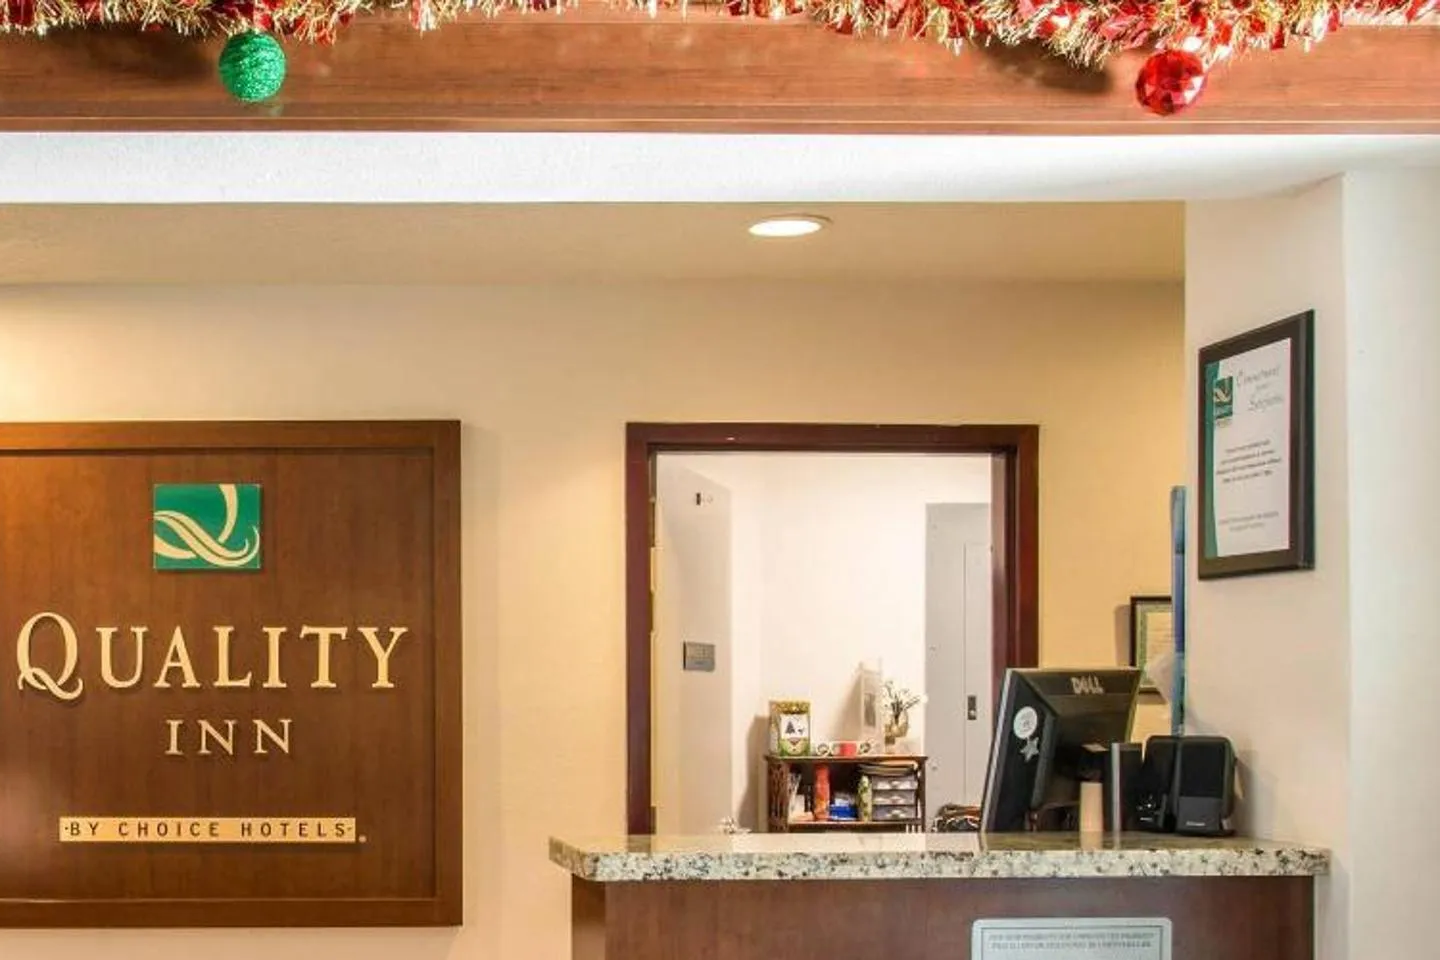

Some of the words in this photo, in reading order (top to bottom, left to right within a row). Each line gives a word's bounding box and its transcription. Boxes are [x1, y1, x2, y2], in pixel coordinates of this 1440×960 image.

[16, 611, 409, 700] QUALITY
[1071, 676, 1104, 694] DELL
[164, 718, 293, 756] INN
[69, 822, 101, 837] BY
[117, 821, 221, 838] CHOICE
[240, 821, 348, 838] HOTELS
